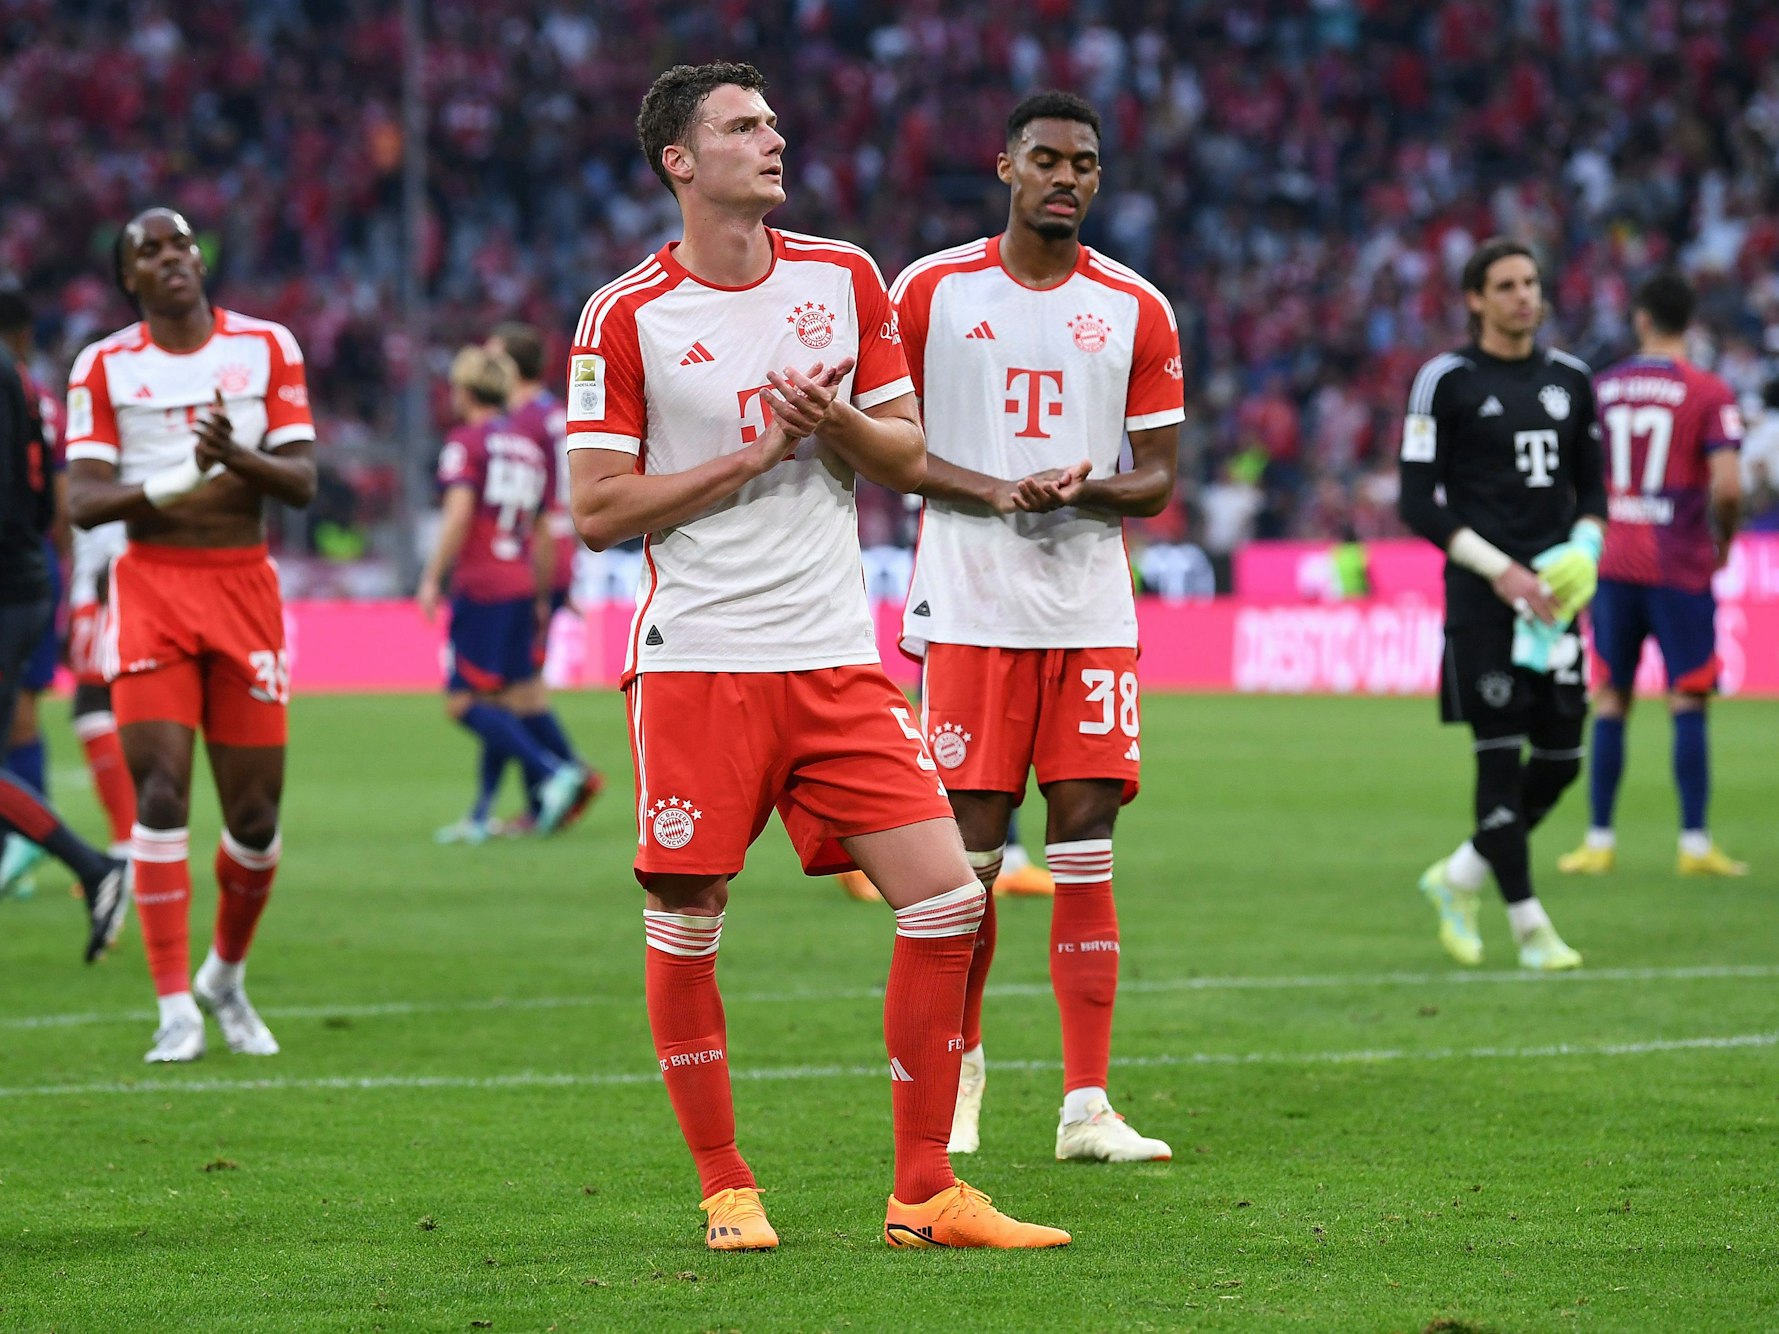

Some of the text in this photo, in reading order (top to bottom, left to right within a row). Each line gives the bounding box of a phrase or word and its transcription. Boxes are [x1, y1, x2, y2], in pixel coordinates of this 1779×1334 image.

[1005, 367, 1063, 439] T
[1514, 429, 1560, 489] T
[1604, 404, 1673, 494] 17
[1079, 668, 1140, 738] 38
[665, 811, 690, 826] BAYERN
[1057, 943, 1075, 954] FC
[670, 1048, 724, 1067] BAYERN
[948, 1038, 961, 1052] FC
